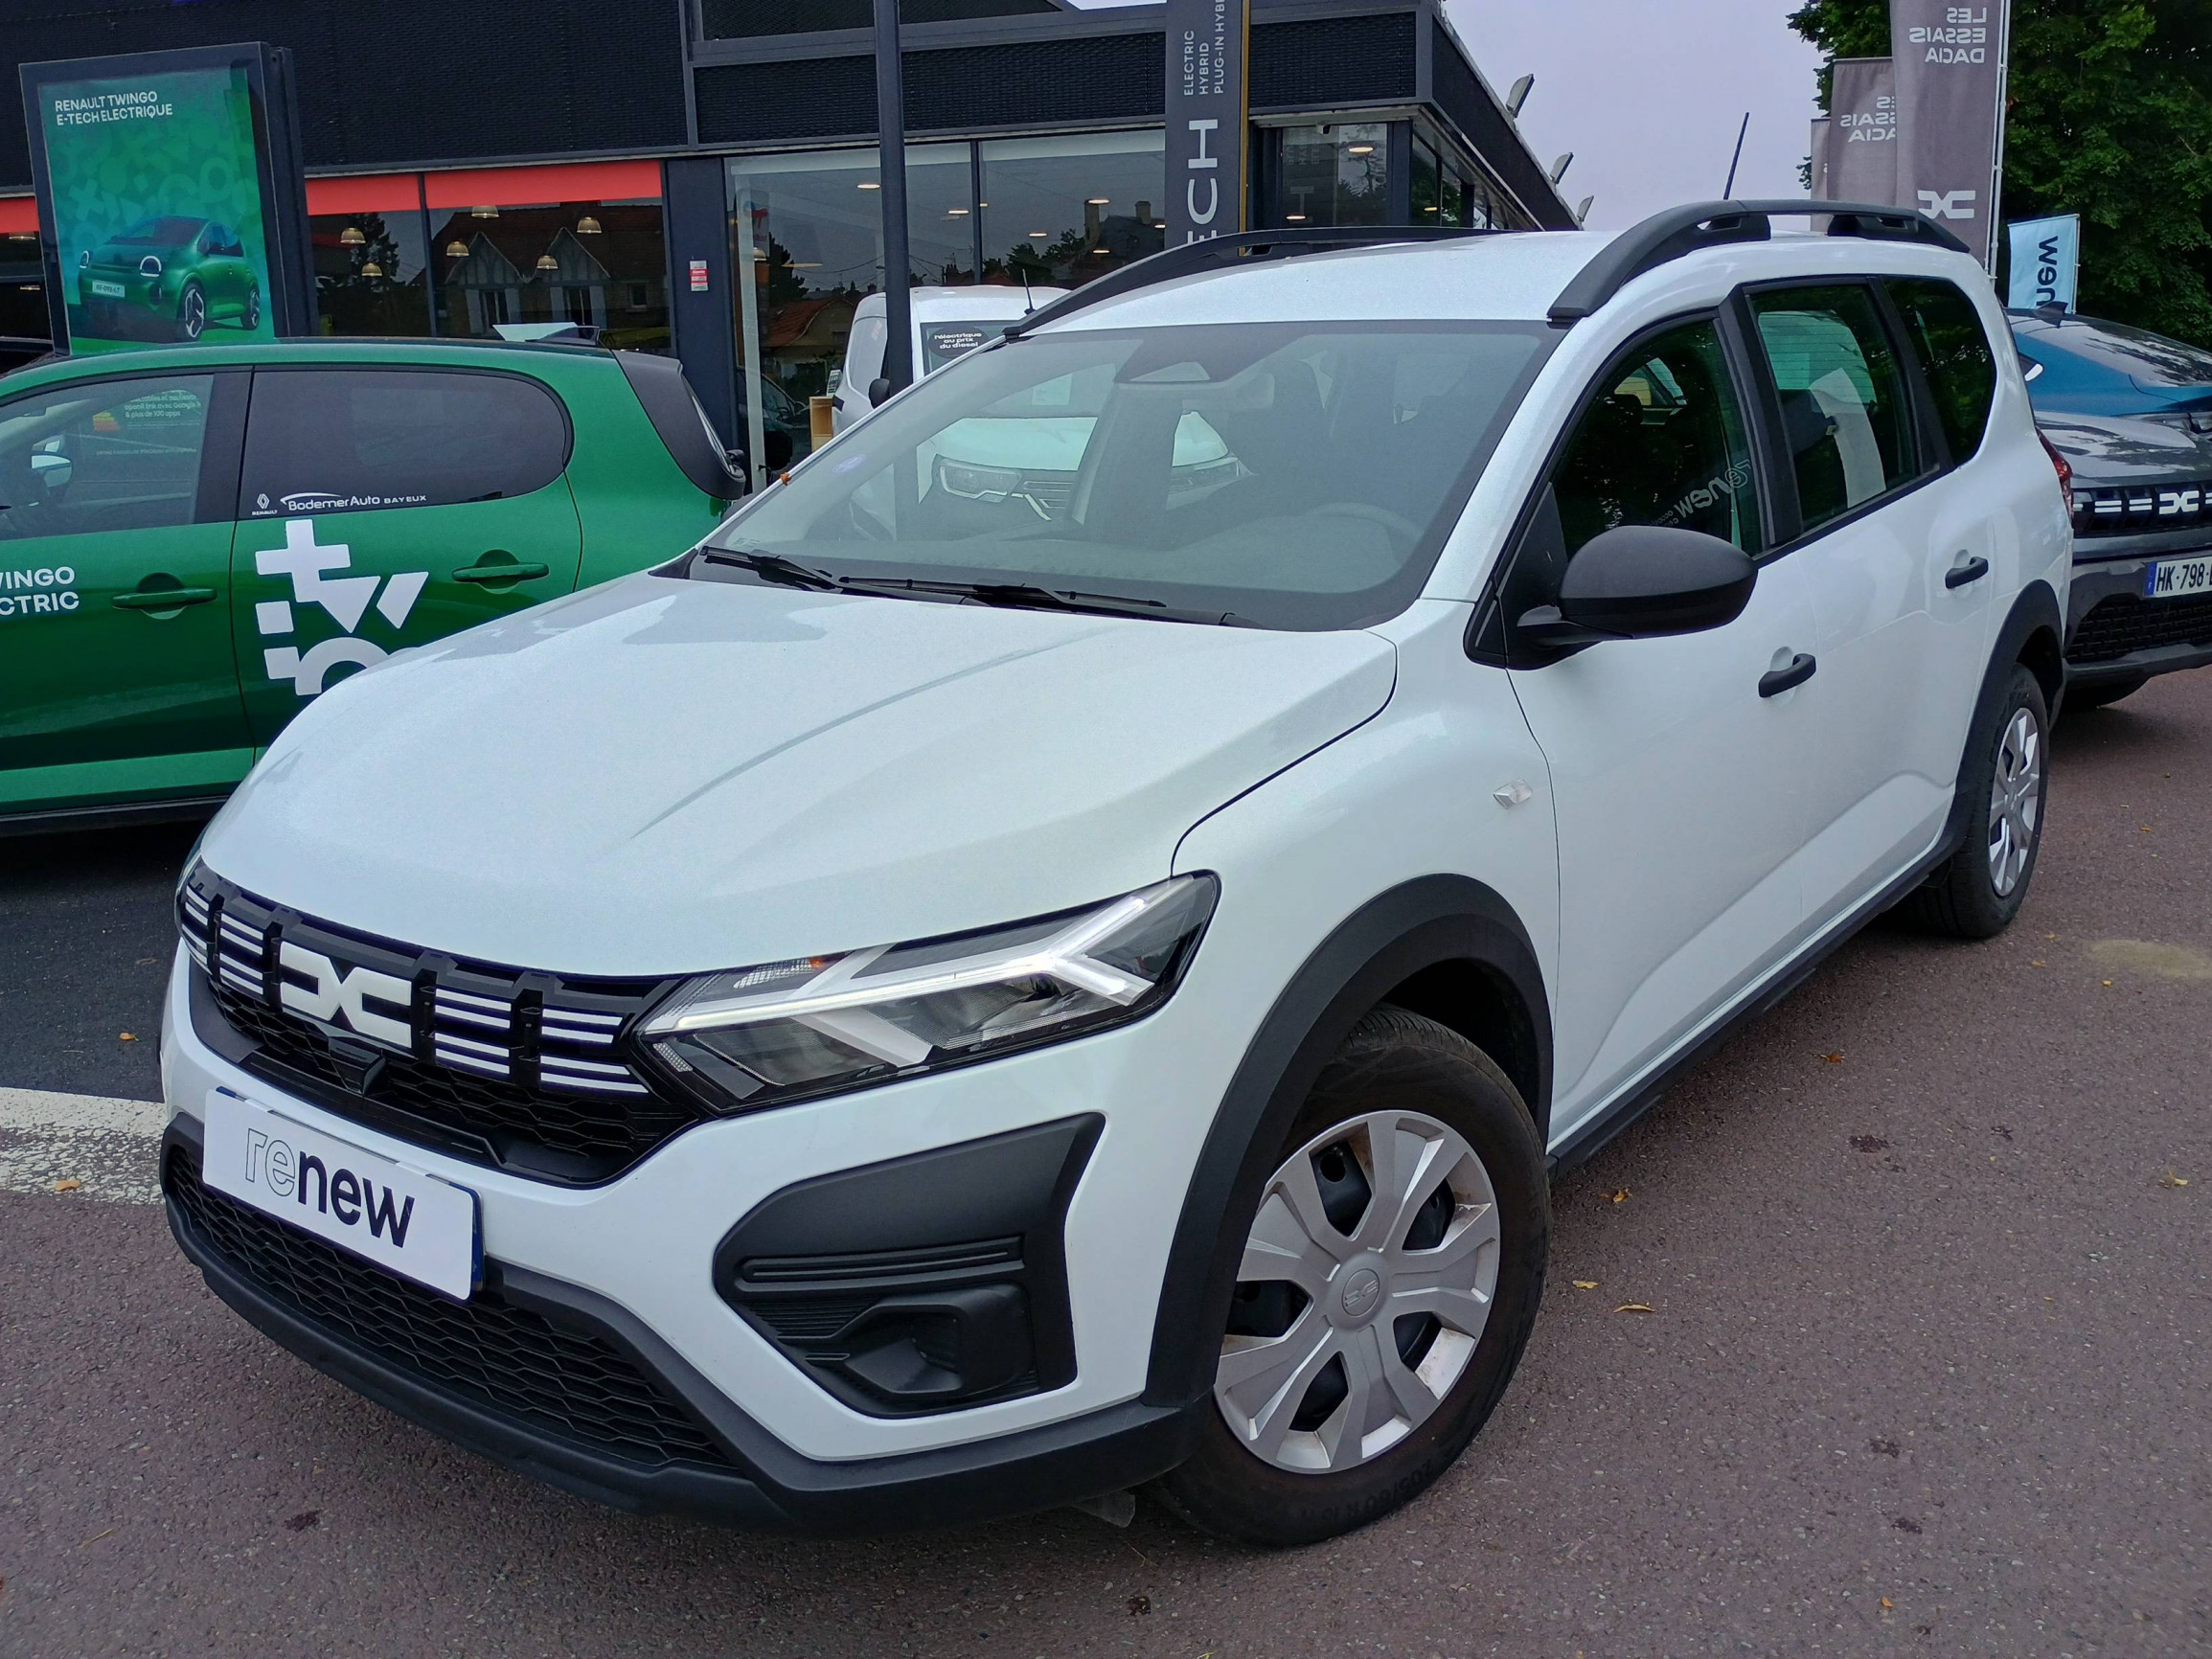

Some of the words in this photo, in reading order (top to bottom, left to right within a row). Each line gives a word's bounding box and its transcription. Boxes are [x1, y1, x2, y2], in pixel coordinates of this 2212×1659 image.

[1184, 31, 1195, 96] ELECTRIC
[1199, 42, 1209, 95] HYBRID
[1214, 35, 1225, 94] PLUG-IN
[55, 96, 105, 112] RENAULT
[107, 91, 158, 106] TWINGO
[57, 112, 100, 126] E-TECH
[102, 103, 173, 123] ELECTRIQUE
[383, 495, 427, 504] BAYEUX
[0, 566, 76, 590] INGO
[244, 1127, 416, 1249] renew
